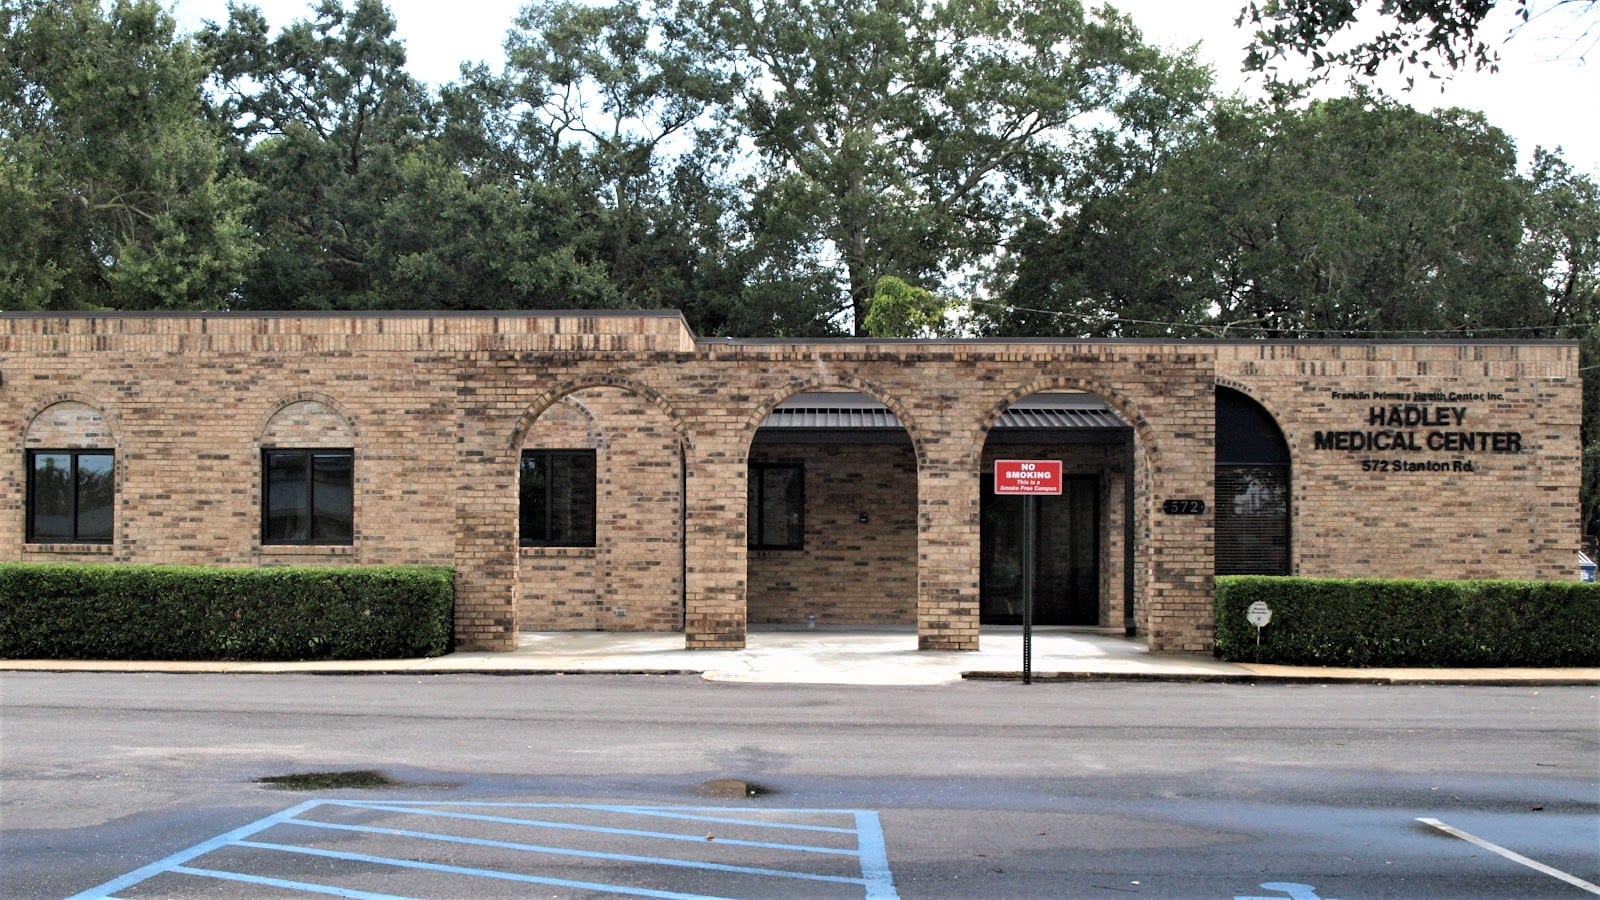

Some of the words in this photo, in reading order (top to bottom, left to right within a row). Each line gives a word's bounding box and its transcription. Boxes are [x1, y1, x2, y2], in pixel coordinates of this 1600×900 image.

[1331, 391, 1370, 400] Franklin
[1373, 391, 1411, 401] Primary
[1414, 391, 1446, 401] Health
[1487, 391, 1504, 401] Inc.
[1369, 407, 1466, 425] HADLEY
[1314, 431, 1422, 451] MEDICAL
[1426, 431, 1522, 451] CENTER
[1362, 460, 1389, 472] 572
[1392, 460, 1450, 472] Stanton
[1170, 501, 1199, 512] 572
